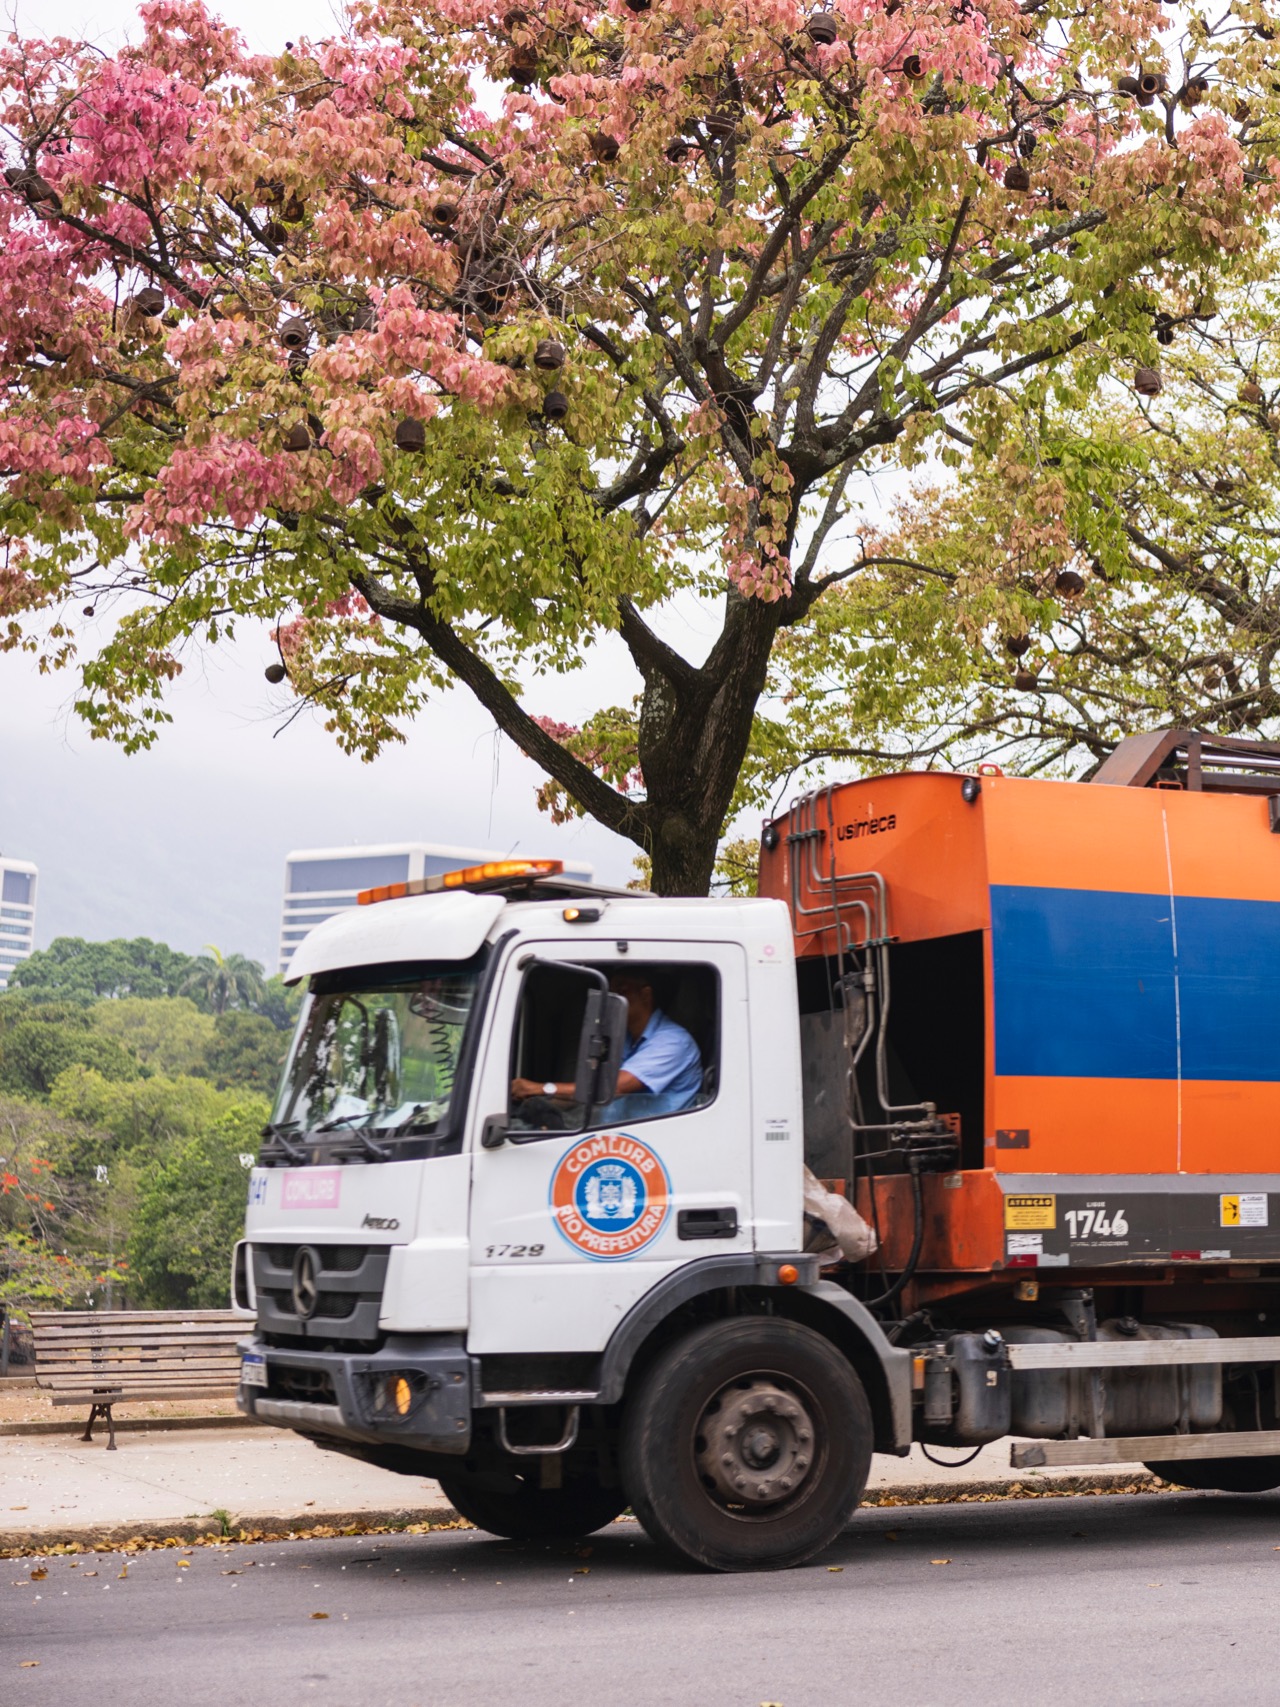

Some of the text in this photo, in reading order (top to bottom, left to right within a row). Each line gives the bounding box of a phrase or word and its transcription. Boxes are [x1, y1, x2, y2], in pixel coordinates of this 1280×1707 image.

[837, 814, 896, 841] usimeca
[566, 1139, 656, 1173] COMLURB
[287, 1179, 335, 1201] COMLURB
[559, 1203, 665, 1251] RIO PREFEITURA
[1064, 1209, 1129, 1239] 1746
